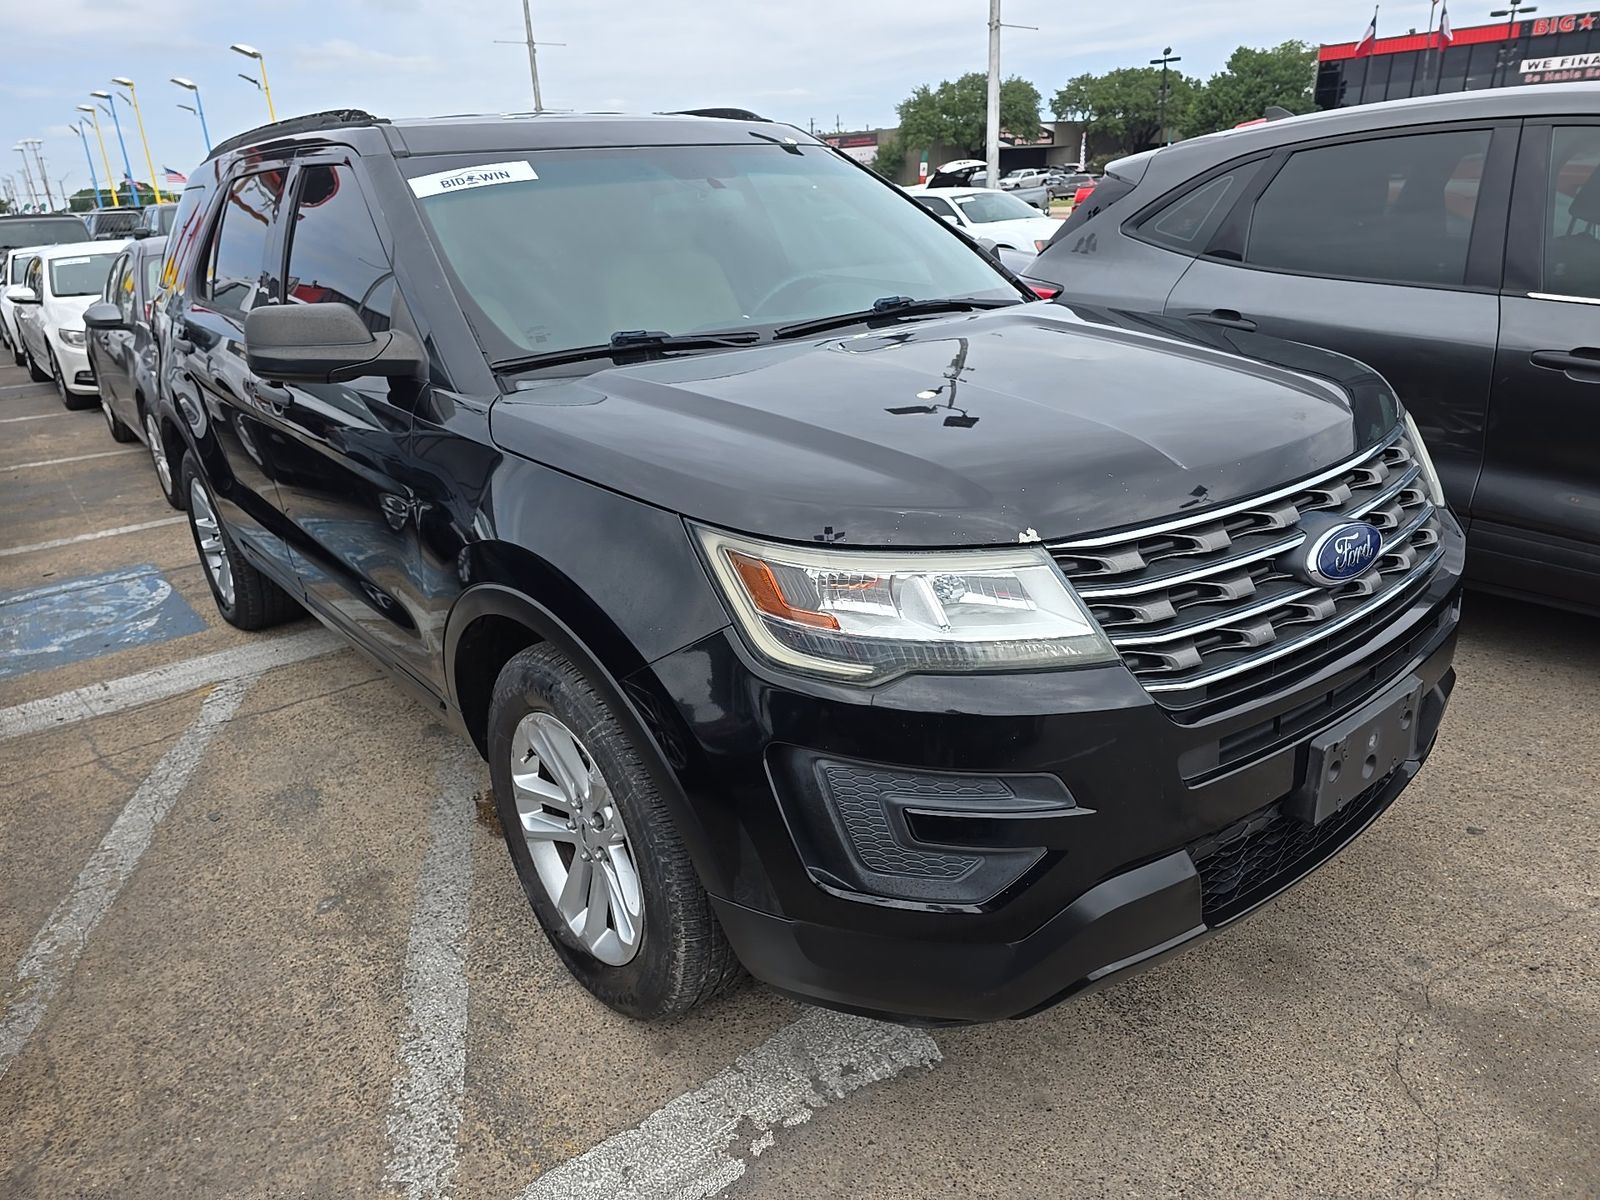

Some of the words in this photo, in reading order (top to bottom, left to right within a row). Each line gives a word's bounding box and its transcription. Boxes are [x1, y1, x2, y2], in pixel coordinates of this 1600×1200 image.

[1531, 15, 1576, 36] BIG
[1527, 60, 1552, 70] WE
[440, 177, 466, 188] BID
[478, 171, 511, 182] WIN
[1335, 532, 1374, 572] Ford
